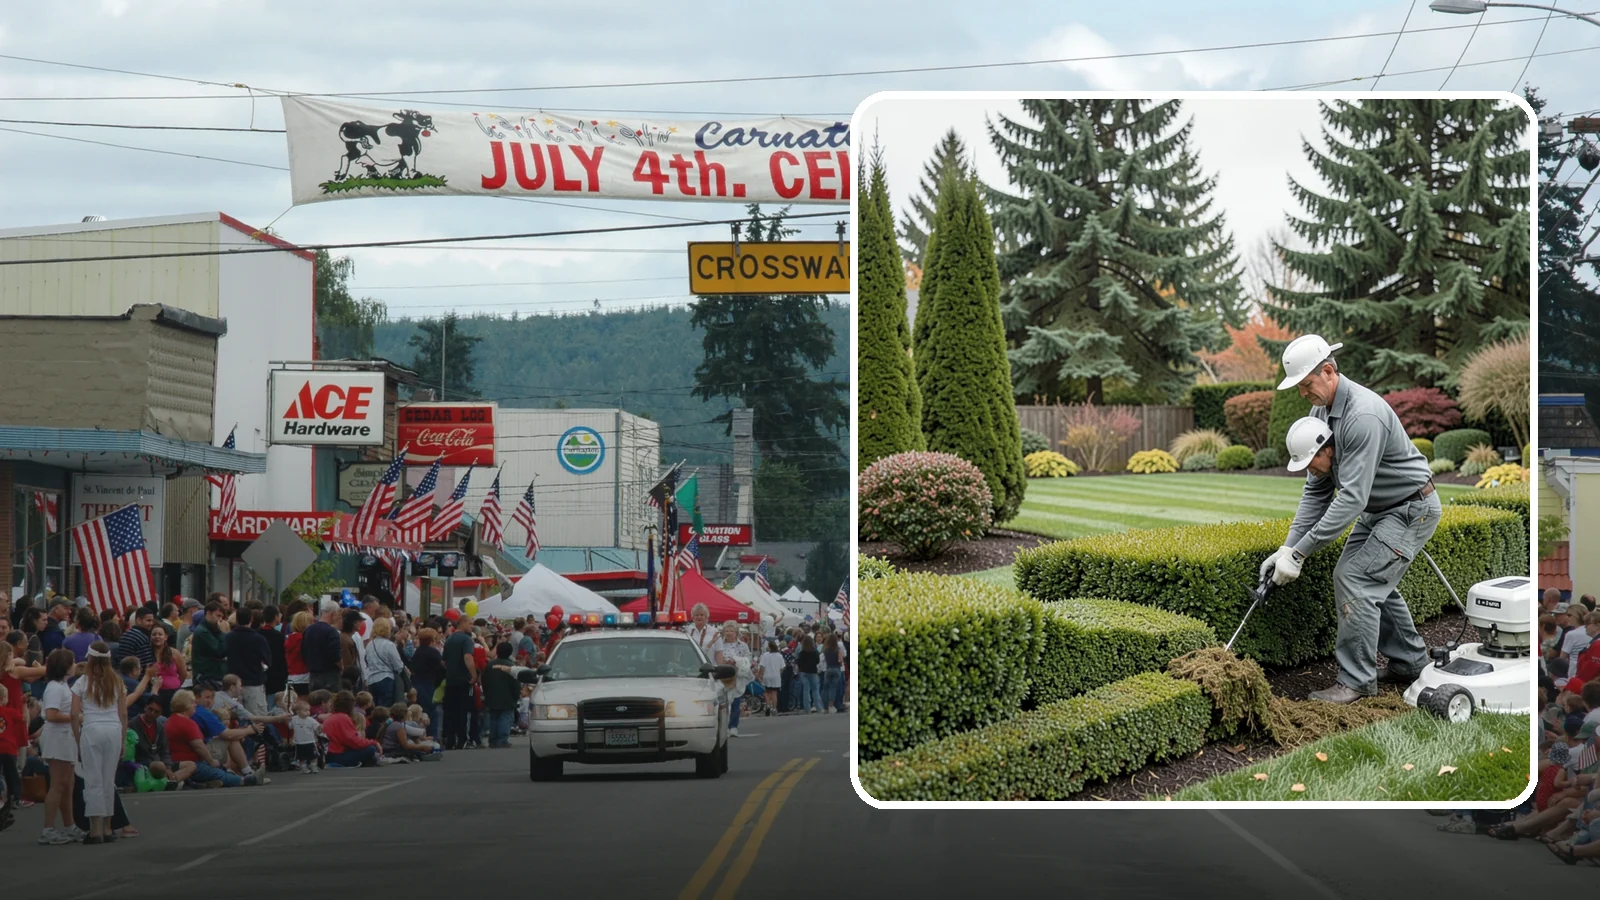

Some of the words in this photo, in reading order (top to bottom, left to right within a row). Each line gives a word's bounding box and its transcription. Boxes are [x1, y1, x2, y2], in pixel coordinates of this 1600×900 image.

[695, 121, 850, 149] Carnat
[481, 141, 604, 192] JULY
[632, 150, 745, 198] 4th.
[697, 254, 850, 280] CROSSWA
[283, 380, 373, 420] ACE
[406, 409, 452, 422] CEDAR
[461, 409, 485, 422] LOG
[283, 421, 370, 436] Hardware
[416, 428, 477, 447] Coca-Cola
[354, 467, 386, 479] Simpl
[95, 484, 124, 495] Vincent
[126, 485, 136, 495] de
[137, 485, 155, 495] Paul
[688, 526, 741, 535] CRNATION
[699, 535, 730, 543] GLASS
